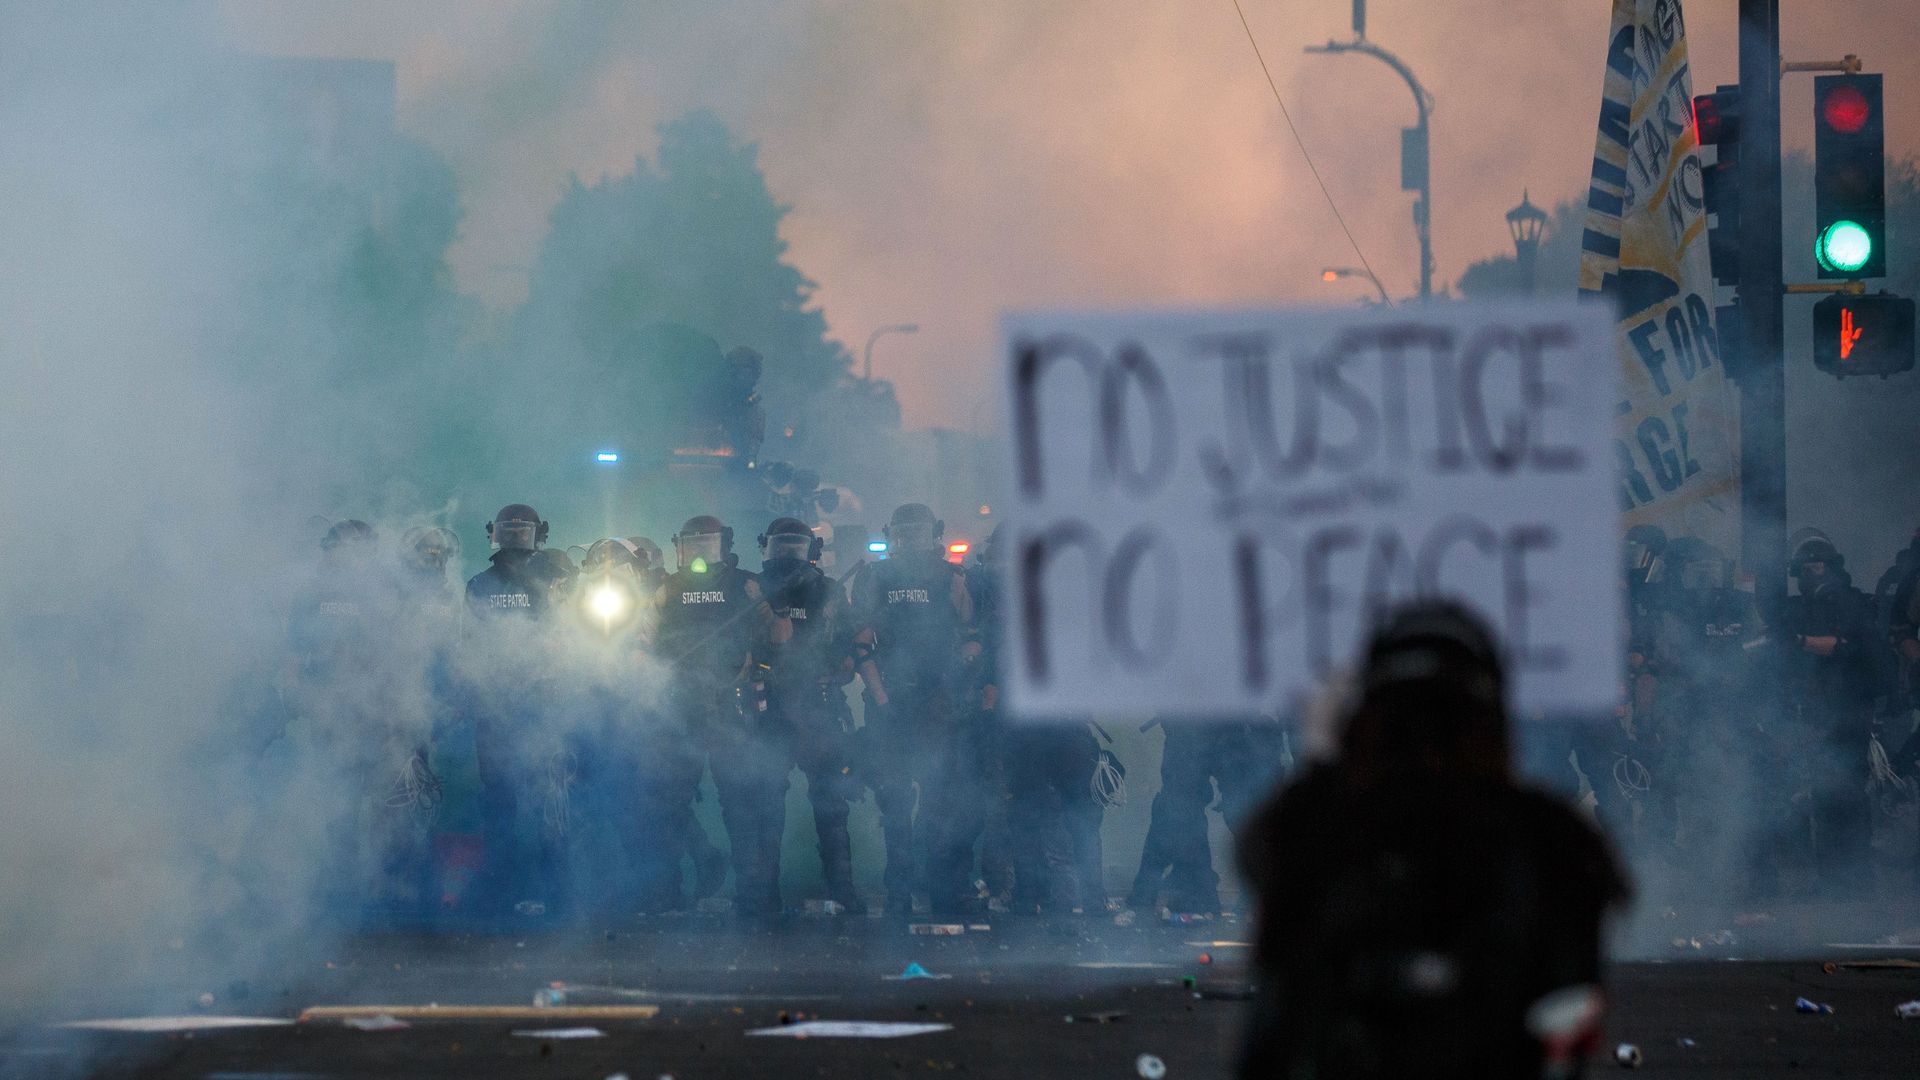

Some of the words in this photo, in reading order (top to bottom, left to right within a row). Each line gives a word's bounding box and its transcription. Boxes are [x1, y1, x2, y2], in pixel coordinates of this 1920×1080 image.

[1628, 293, 1719, 397] FOR
[1188, 322, 1587, 490] JUSTICE
[490, 594, 507, 609] STATE
[507, 593, 531, 608] PATROL
[682, 592, 701, 605] STATE
[701, 591, 725, 604] PATROL
[887, 590, 906, 604] STATE
[906, 589, 929, 604] PATROL
[789, 607, 807, 619] ATROL
